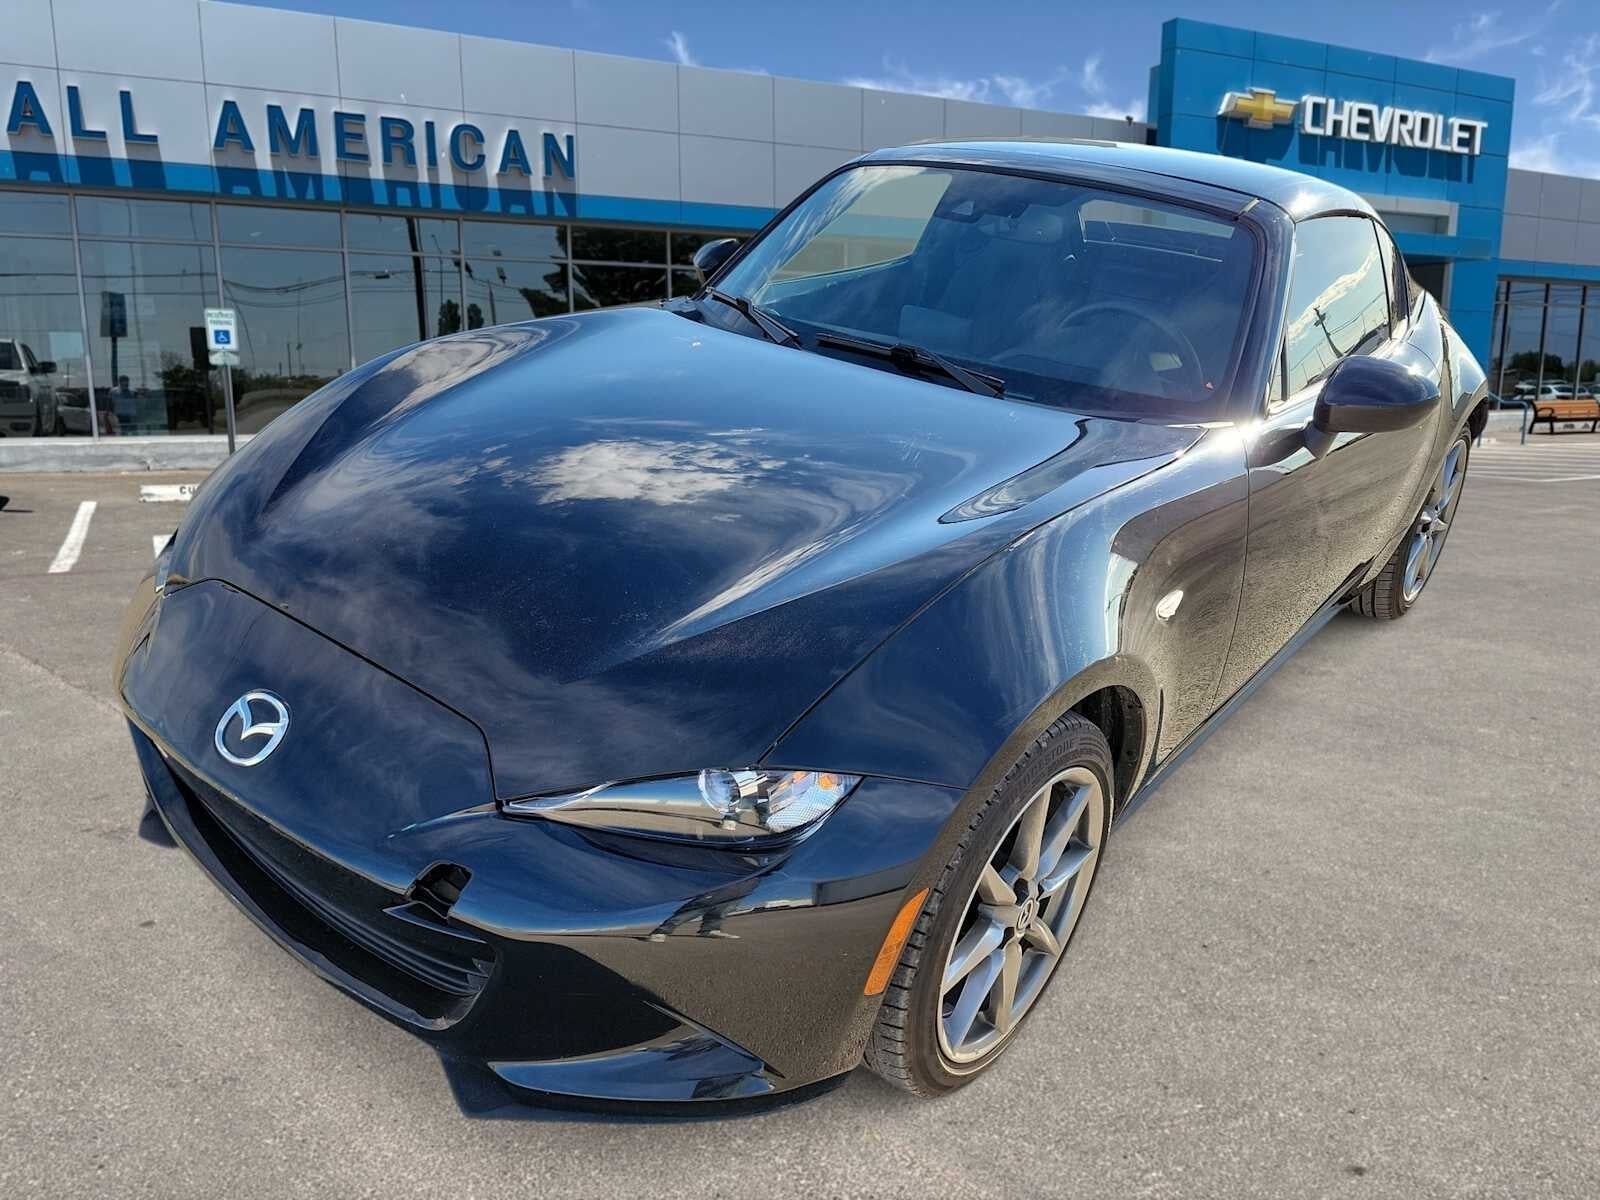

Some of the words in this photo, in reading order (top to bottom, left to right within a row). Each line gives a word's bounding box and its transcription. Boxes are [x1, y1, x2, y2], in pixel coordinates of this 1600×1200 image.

[7, 80, 158, 144] ALL
[213, 99, 577, 178] AMERICAN
[1302, 95, 1488, 155] CHEVROLET
